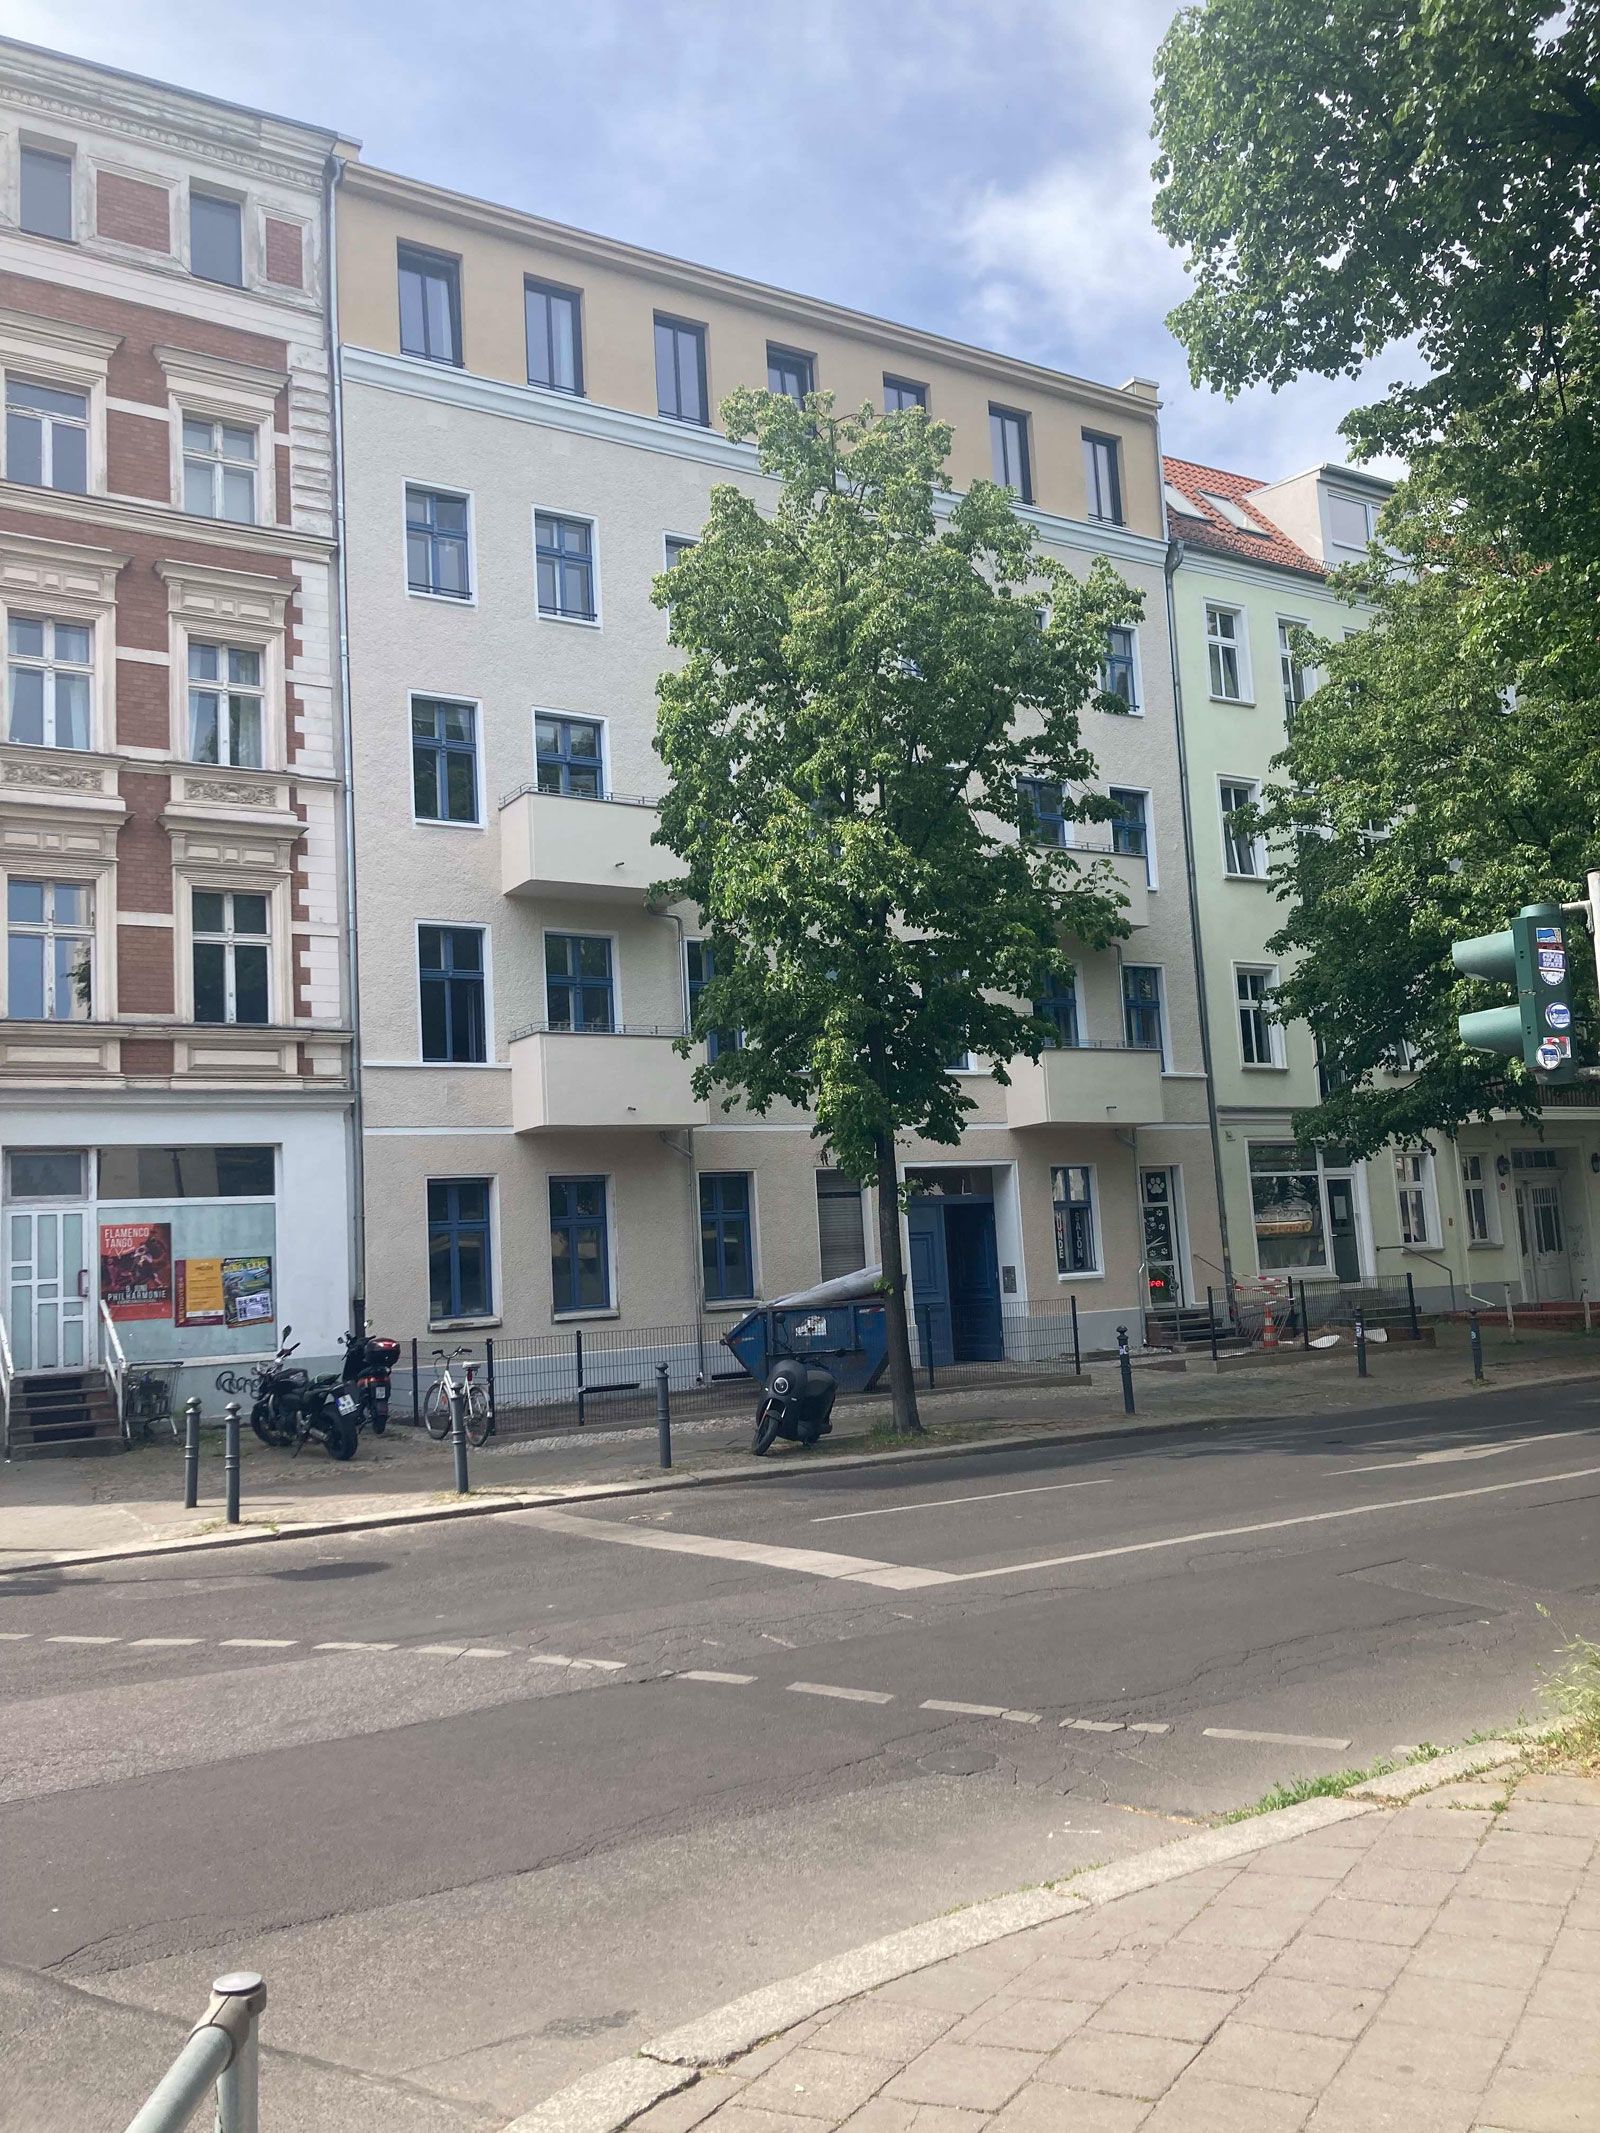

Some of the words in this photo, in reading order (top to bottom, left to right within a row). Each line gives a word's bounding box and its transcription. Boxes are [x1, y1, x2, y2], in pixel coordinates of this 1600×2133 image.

[104, 1227, 149, 1239] FLAMENCO
[1056, 1212, 1064, 1259] HUNDE
[1074, 1212, 1083, 1258] SALON
[104, 1238, 133, 1248] TANGO
[107, 1290, 167, 1301] PHILHARMONIE
[238, 1296, 268, 1305] BERLIN
